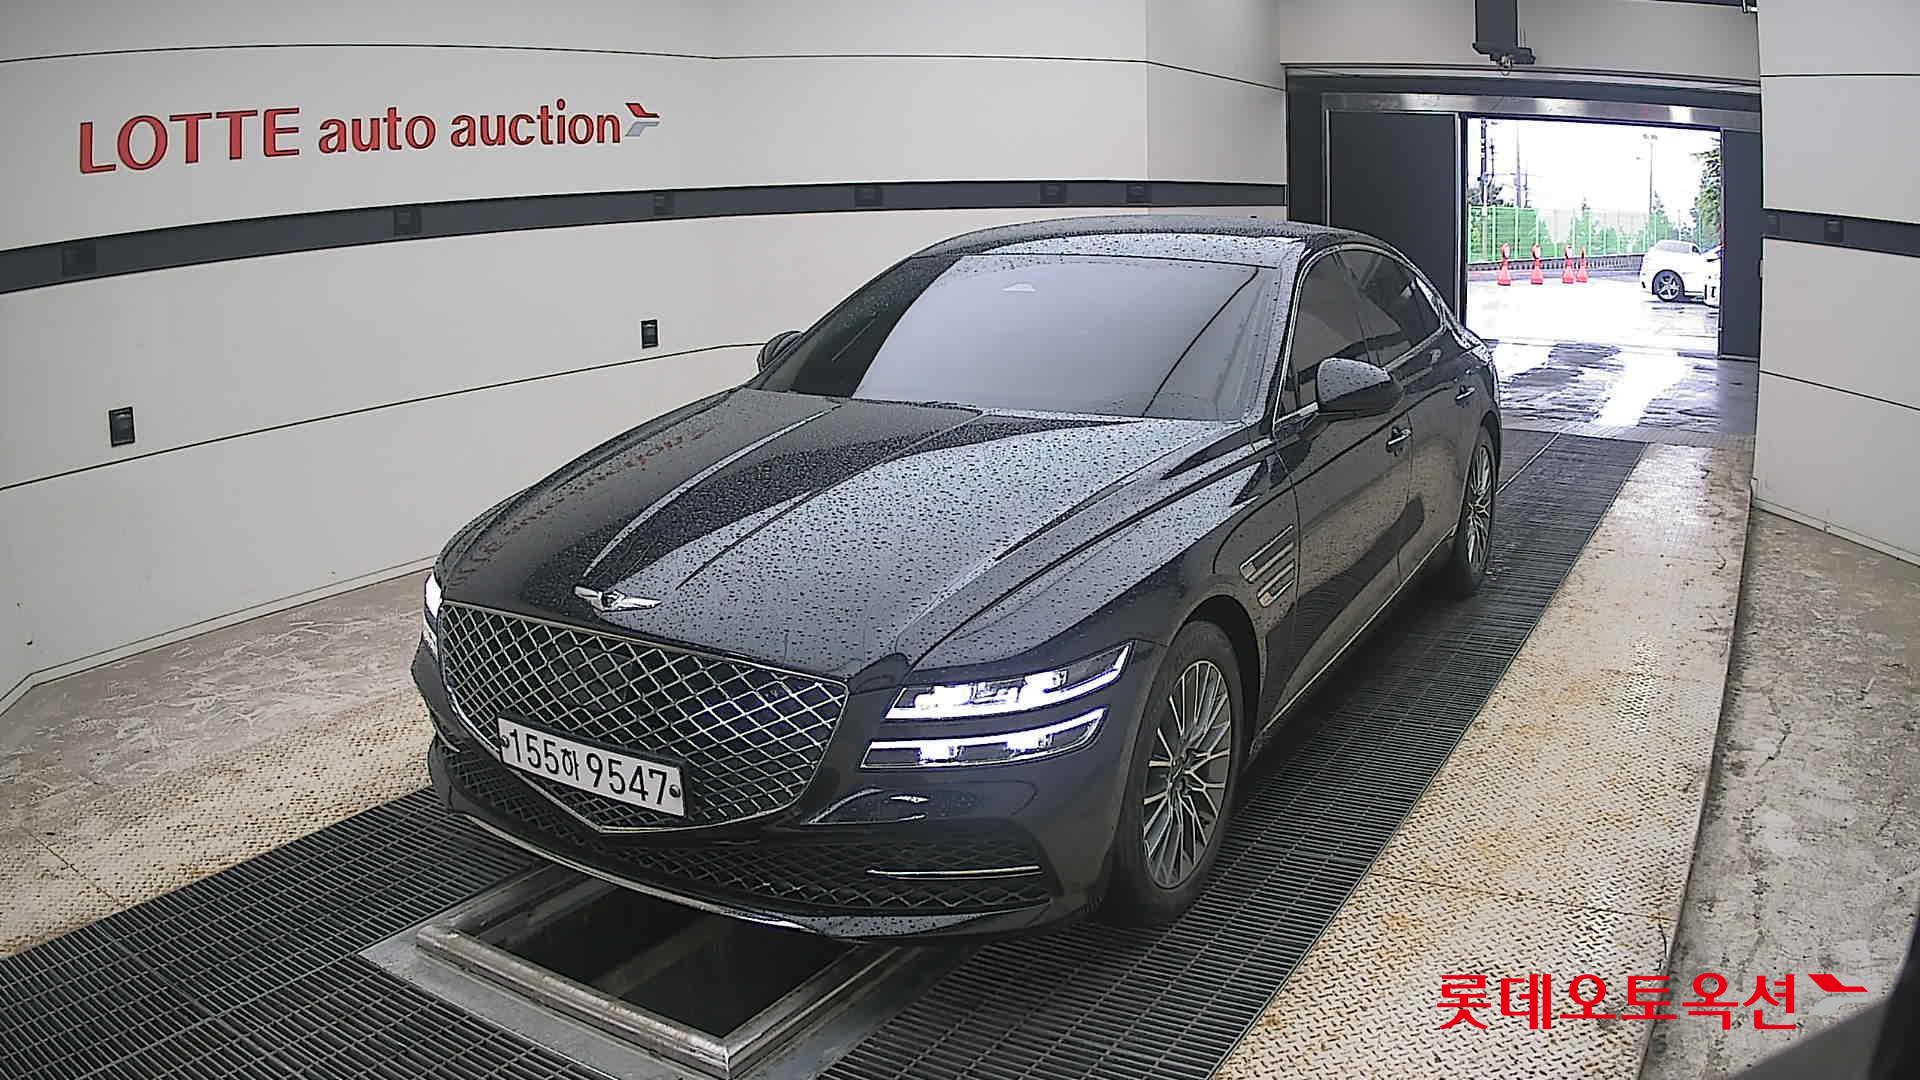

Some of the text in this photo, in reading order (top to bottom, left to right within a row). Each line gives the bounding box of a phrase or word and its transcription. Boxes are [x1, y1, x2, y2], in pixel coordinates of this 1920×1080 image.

[79, 98, 622, 174] LOTTE auto auction
[585, 752, 668, 805] 9547
